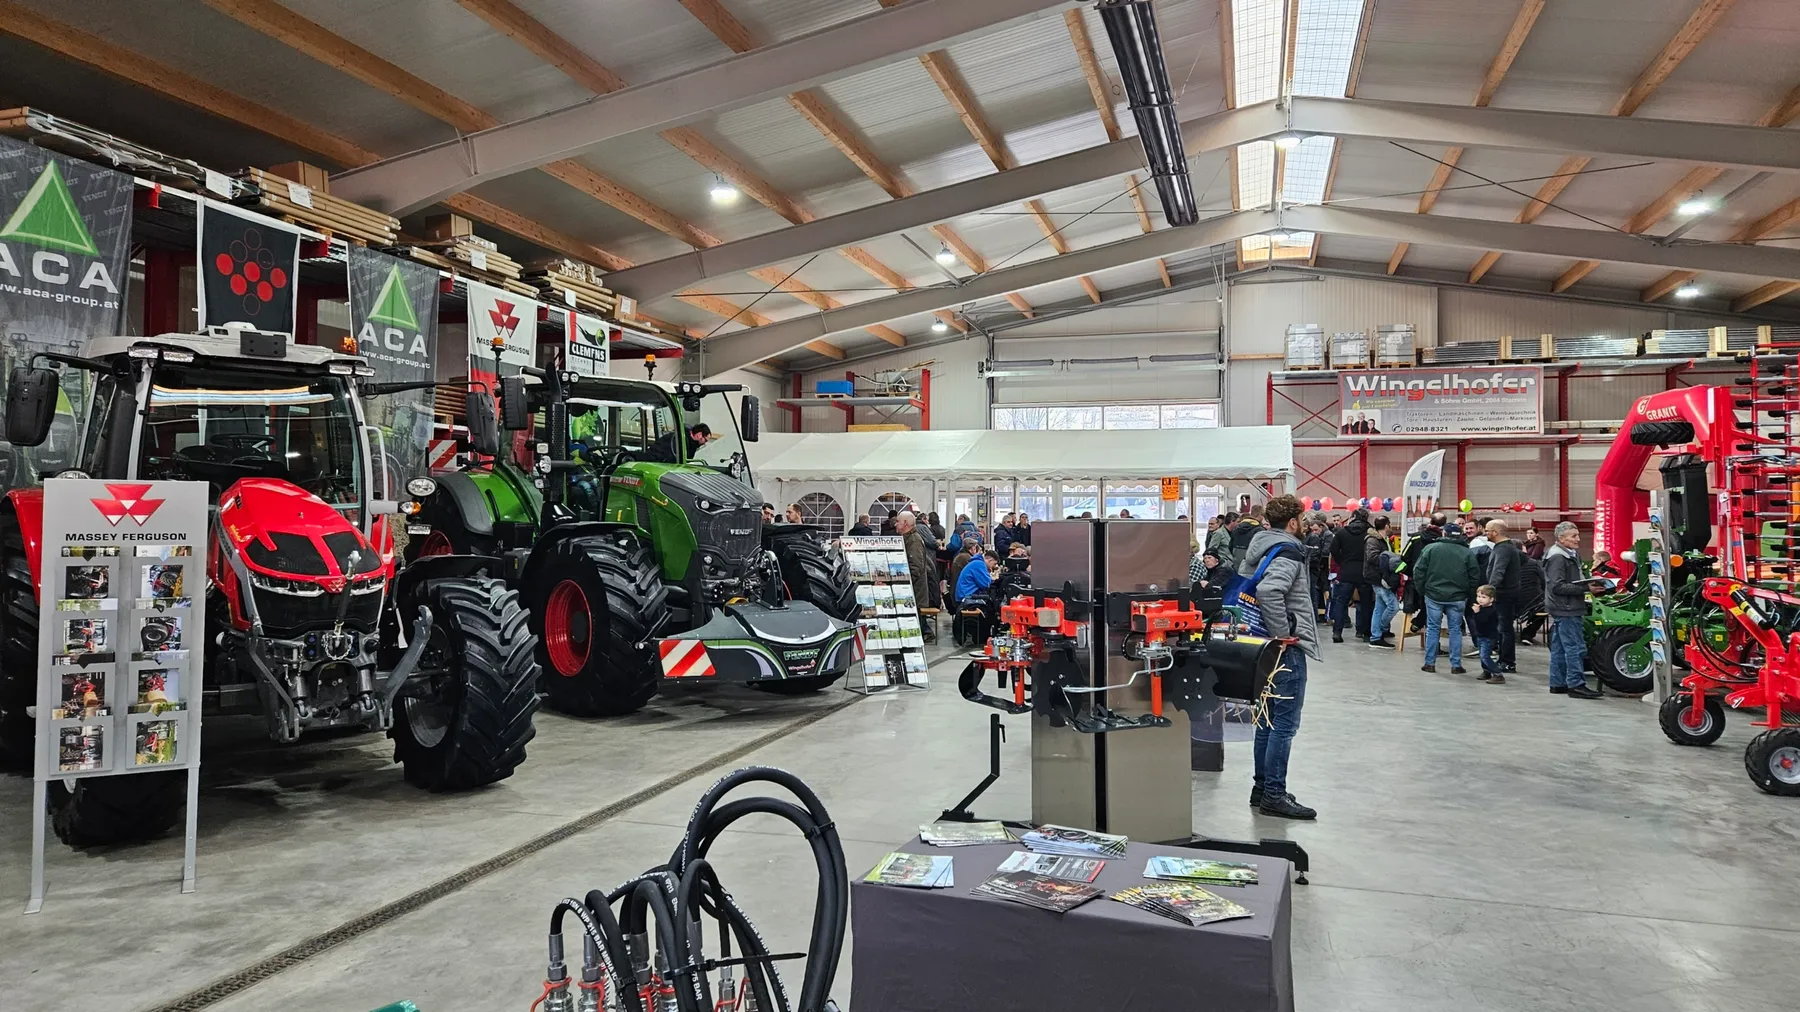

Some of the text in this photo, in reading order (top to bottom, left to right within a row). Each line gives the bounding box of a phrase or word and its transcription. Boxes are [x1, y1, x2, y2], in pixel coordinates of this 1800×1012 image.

[0, 242, 119, 294] ACA
[358, 322, 428, 358] ACA
[1346, 373, 1535, 401] Wingelhofer
[1646, 406, 1678, 420] GRANIT
[1594, 499, 1604, 553] GRANIT
[580, 911, 591, 922] WP
[594, 935, 605, 952] BAR
[694, 982, 703, 1000] BAR
